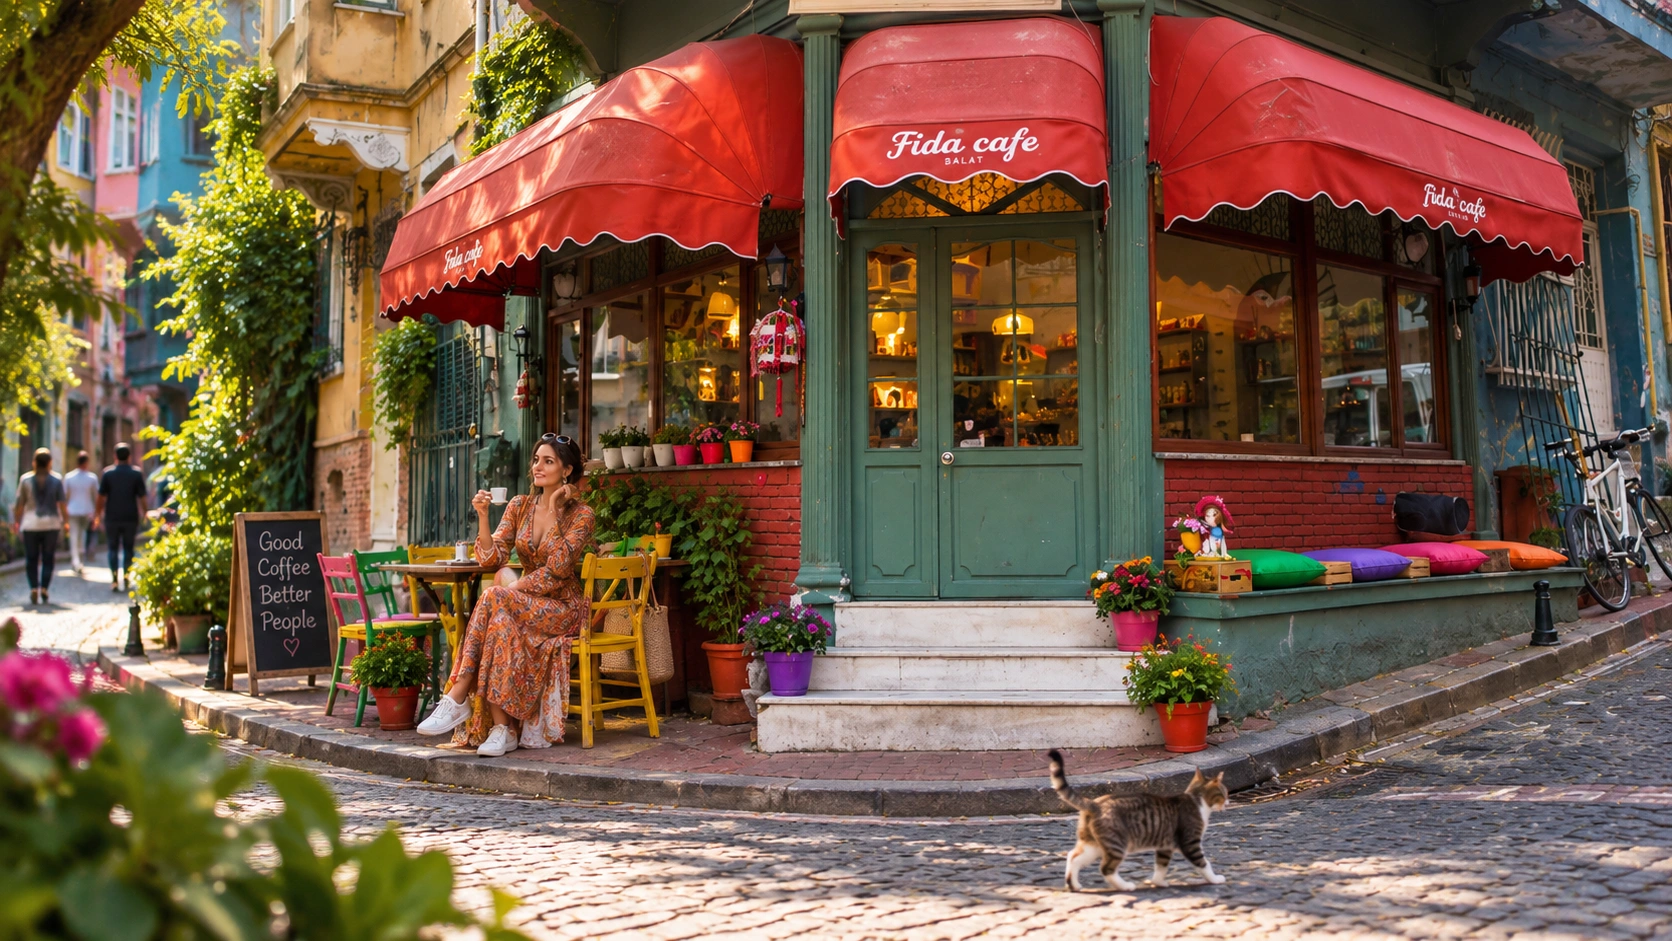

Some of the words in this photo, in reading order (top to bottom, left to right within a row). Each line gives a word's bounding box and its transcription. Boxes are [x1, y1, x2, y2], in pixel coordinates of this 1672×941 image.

[886, 129, 966, 160] Fida
[972, 126, 1040, 162] cafe
[944, 155, 984, 166] BALAT
[1422, 183, 1456, 208] Fida
[1459, 197, 1487, 224] cafe
[258, 530, 304, 552] Good
[257, 556, 311, 581] Coffee
[258, 584, 312, 605] Better
[260, 608, 317, 637] People
